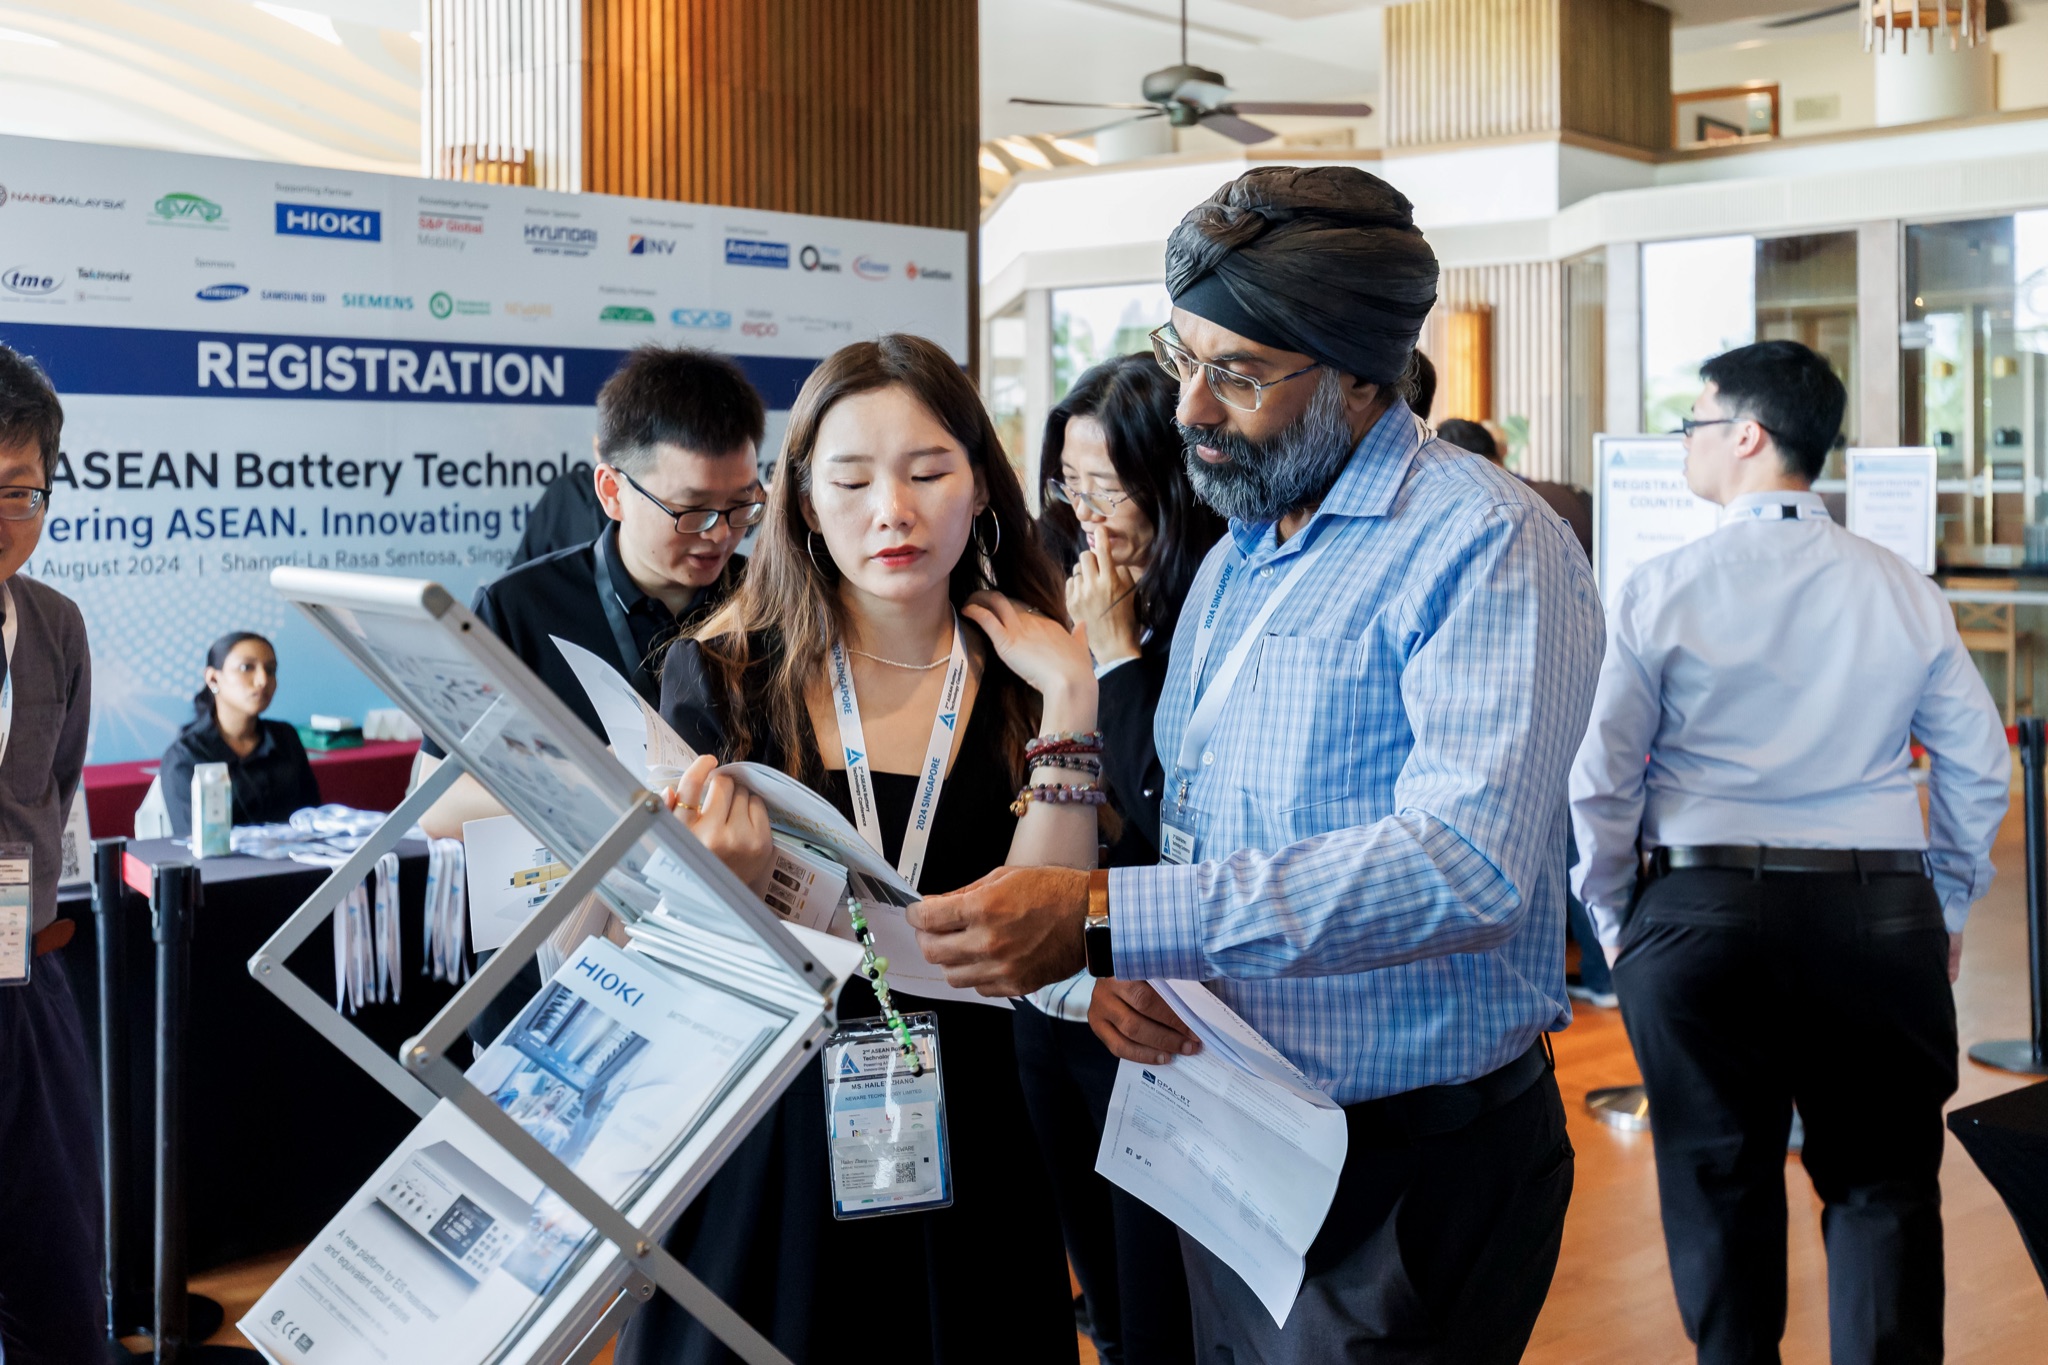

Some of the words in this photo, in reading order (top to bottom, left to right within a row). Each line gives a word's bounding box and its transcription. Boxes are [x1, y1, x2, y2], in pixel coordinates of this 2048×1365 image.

[275, 182, 321, 196] Supporting
[323, 186, 353, 198] Partner
[10, 191, 125, 210] NANOMALAYSIA
[286, 209, 372, 236] HIOKI
[418, 217, 443, 232] S&P
[446, 219, 484, 235] Global
[417, 234, 467, 251] Mobility
[524, 224, 598, 243] HYUNDAI
[728, 240, 788, 260] Amphenol
[11, 272, 54, 289] tme
[76, 266, 132, 282] Tektronix
[260, 290, 308, 302] SAMSUNG
[311, 292, 326, 303] SDI
[342, 292, 414, 310] SIEMENS
[740, 321, 778, 338] expo
[197, 340, 565, 398] REGISTRATION
[51, 450, 218, 489] ASEAN
[236, 450, 403, 496] Battery
[1630, 497, 1694, 508] COUNTER
[48, 507, 153, 548] ering
[167, 506, 307, 538] ASEAN.
[322, 503, 501, 540] Innovating
[41, 556, 119, 580] August
[126, 554, 180, 575] 2024
[221, 549, 329, 573] Shangri-La
[335, 549, 379, 569] Rasa
[385, 545, 463, 568] Sentosa,
[1204, 610, 1217, 630] 2024
[1211, 562, 1235, 609] SINGAPORE
[835, 660, 853, 715] SINGAPORE
[950, 685, 960, 711] Technology
[955, 659, 964, 685] Conference
[860, 774, 868, 793] ASEAN
[921, 757, 941, 809] SINGAPORE
[853, 765, 861, 796] Technology
[858, 796, 867, 827] Conference
[863, 792, 871, 813] Battery
[916, 809, 928, 831] 2024
[575, 955, 645, 1008] HIOKI
[871, 1046, 891, 1055] ASEAN
[892, 1077, 915, 1086] ZHANG
[1157, 1078, 1191, 1105] OPAL-RT
[845, 1094, 867, 1102] NEWARE
[903, 1088, 922, 1096] LIMITED
[336, 1228, 347, 1240] A
[343, 1236, 359, 1253] new
[356, 1248, 386, 1276] platform
[383, 1269, 395, 1283] for
[323, 1243, 341, 1259] and
[337, 1255, 374, 1290] equivalent
[369, 1285, 392, 1306] circuit
